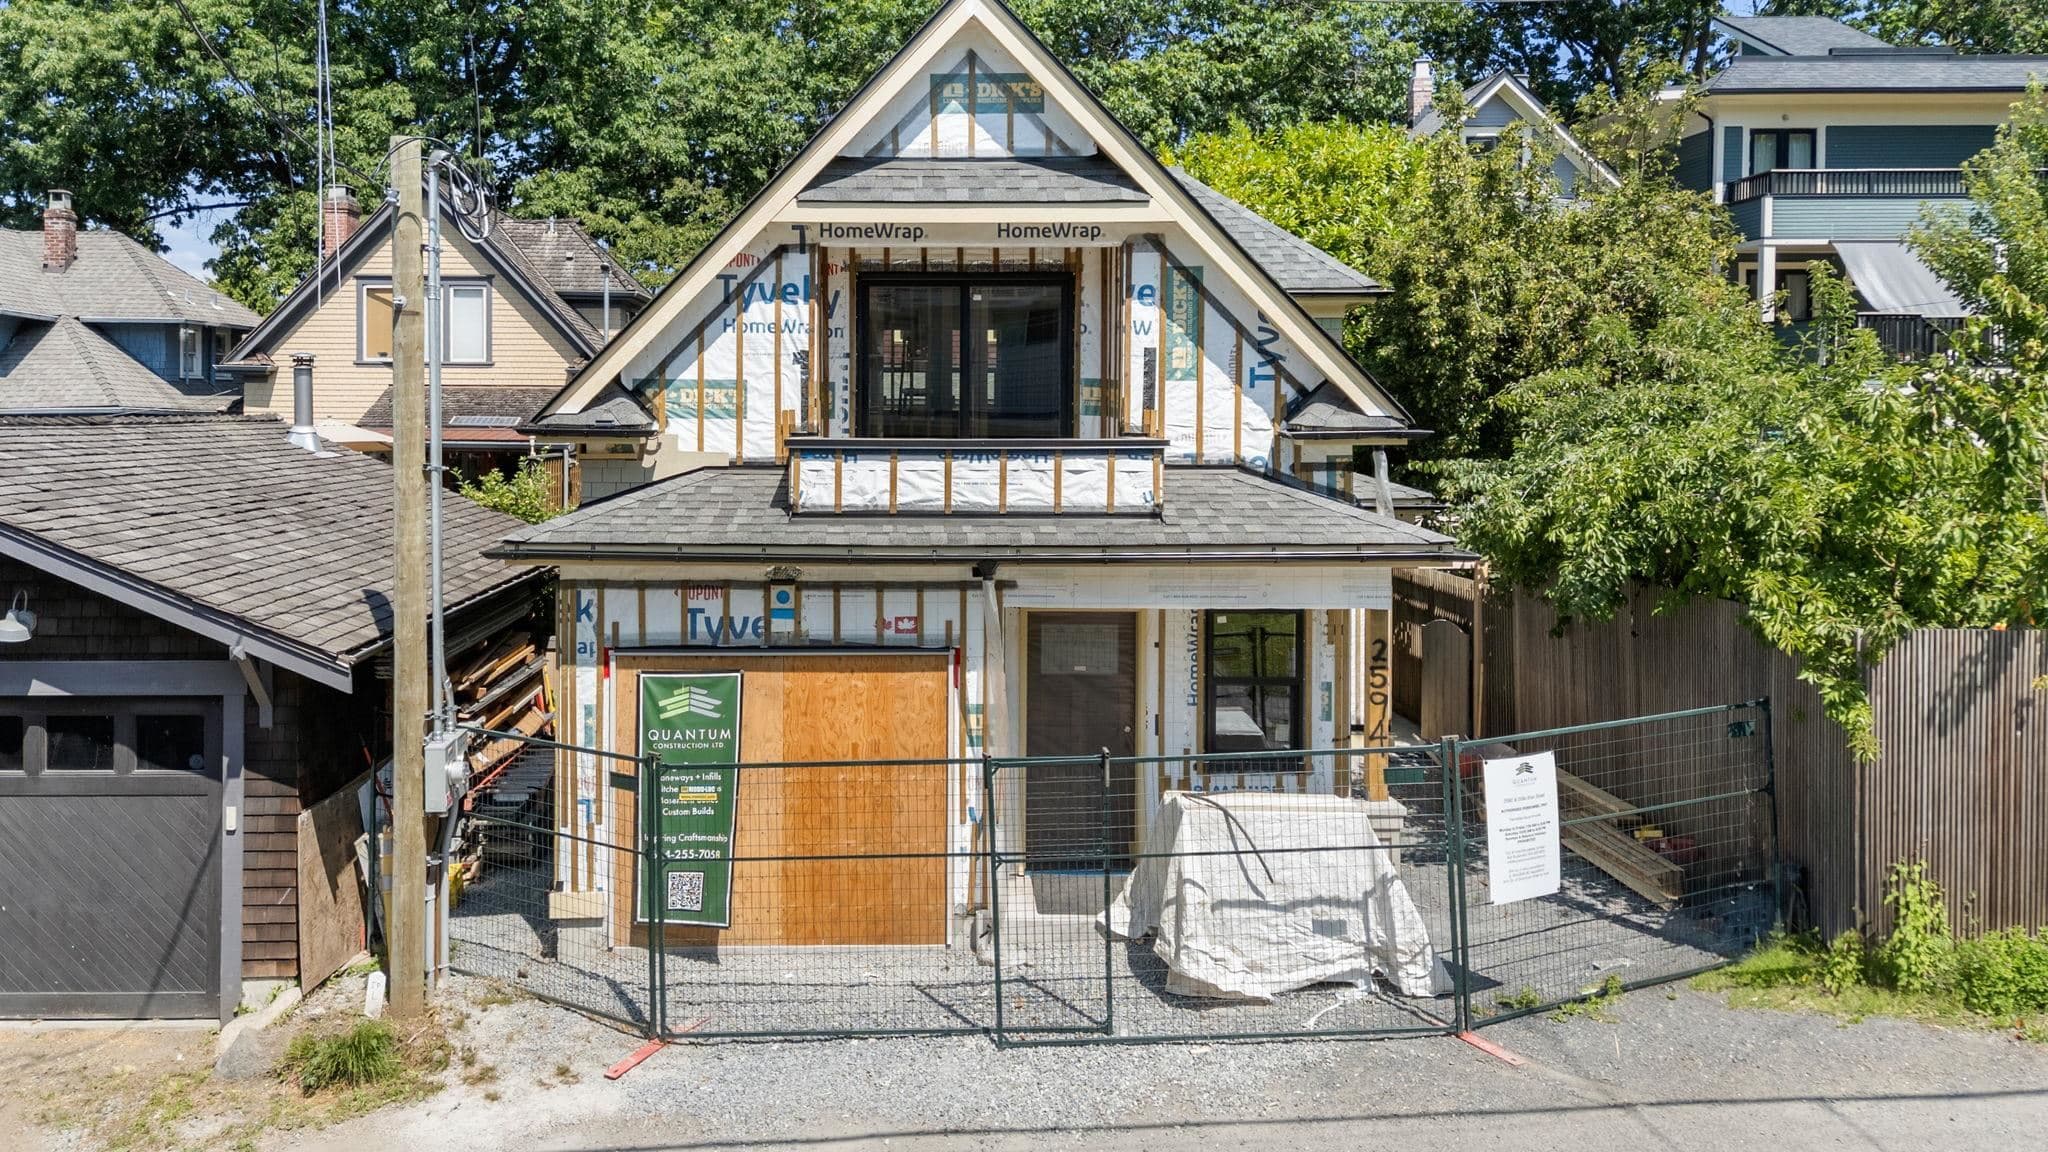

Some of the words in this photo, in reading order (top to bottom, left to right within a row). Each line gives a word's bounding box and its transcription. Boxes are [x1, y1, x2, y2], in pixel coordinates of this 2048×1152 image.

[688, 585, 724, 600] UPONT
[688, 608, 765, 646] Tyve
[648, 729, 731, 740] QUANTUM
[660, 775, 694, 783] aneways
[702, 771, 722, 780] Infills
[662, 807, 691, 816] Custom
[692, 806, 715, 815] Builds
